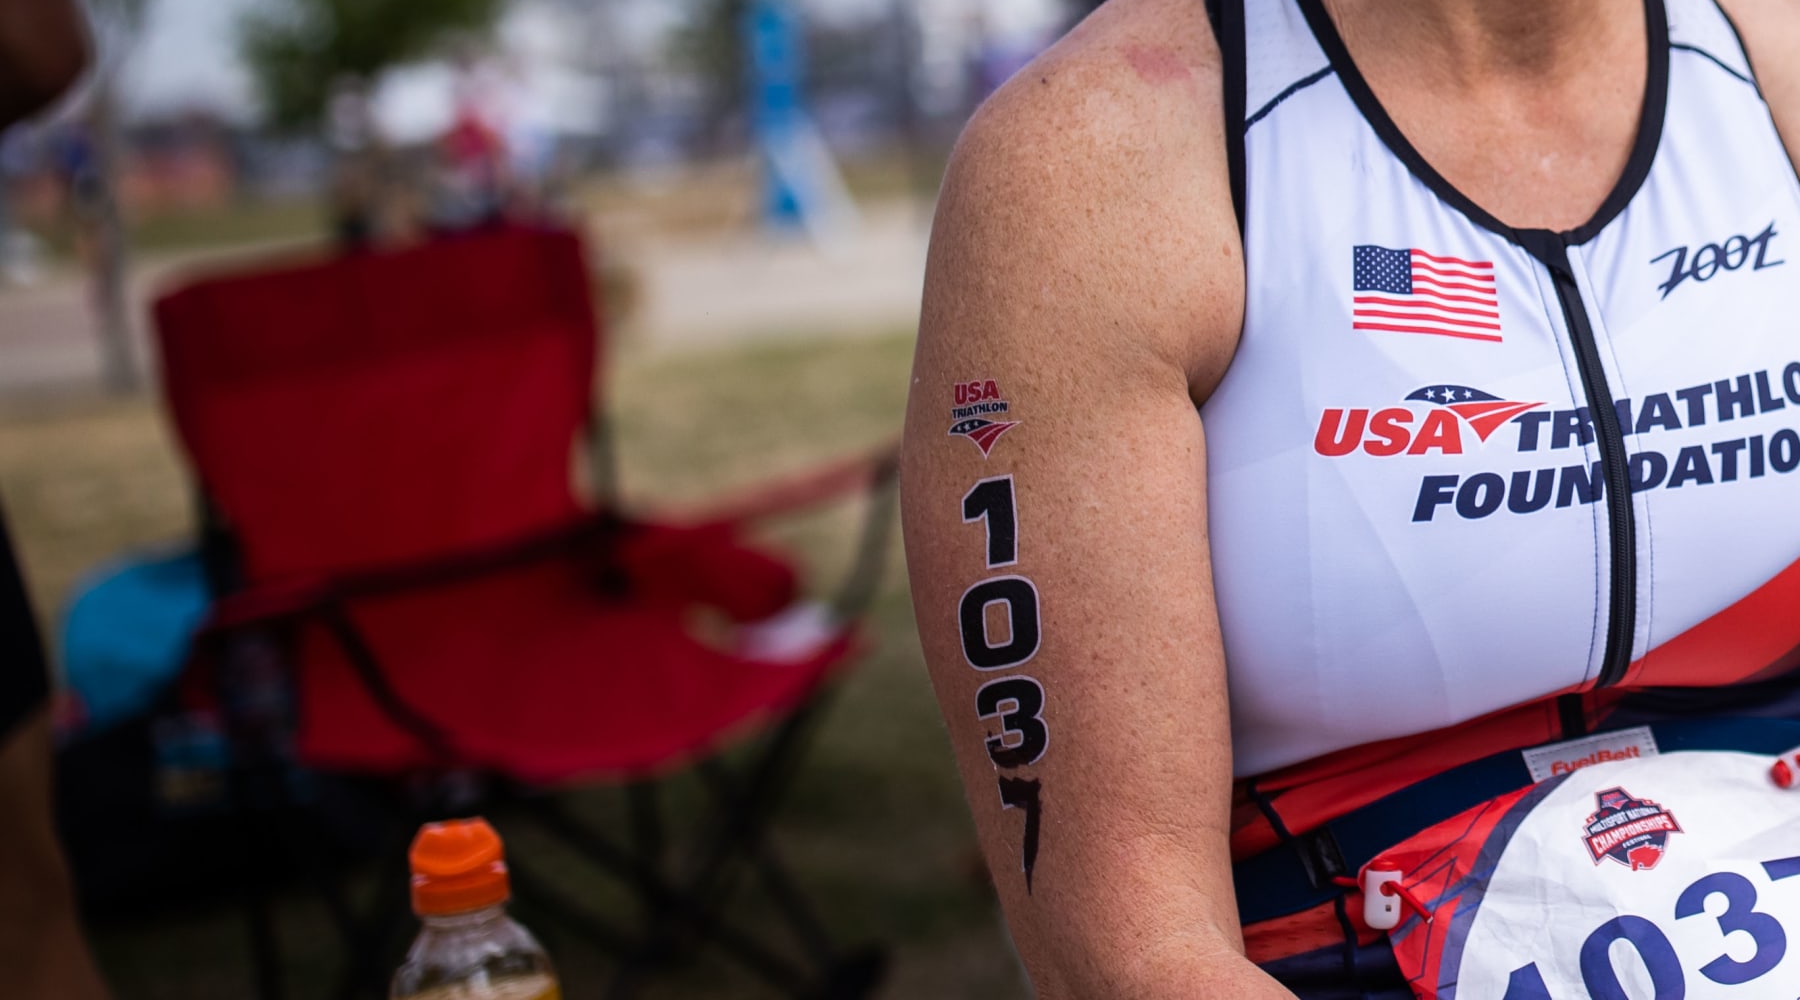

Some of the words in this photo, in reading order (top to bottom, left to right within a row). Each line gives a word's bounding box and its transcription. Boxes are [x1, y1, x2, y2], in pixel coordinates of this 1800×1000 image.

[954, 379, 1000, 402] USA
[951, 402, 1008, 419] TRIATHLON
[1314, 408, 1463, 457] USA
[957, 473, 1050, 897] 1037
[1551, 745, 1640, 776] FuelBelt
[1591, 813, 1674, 855] CHAMPIONSHIPS
